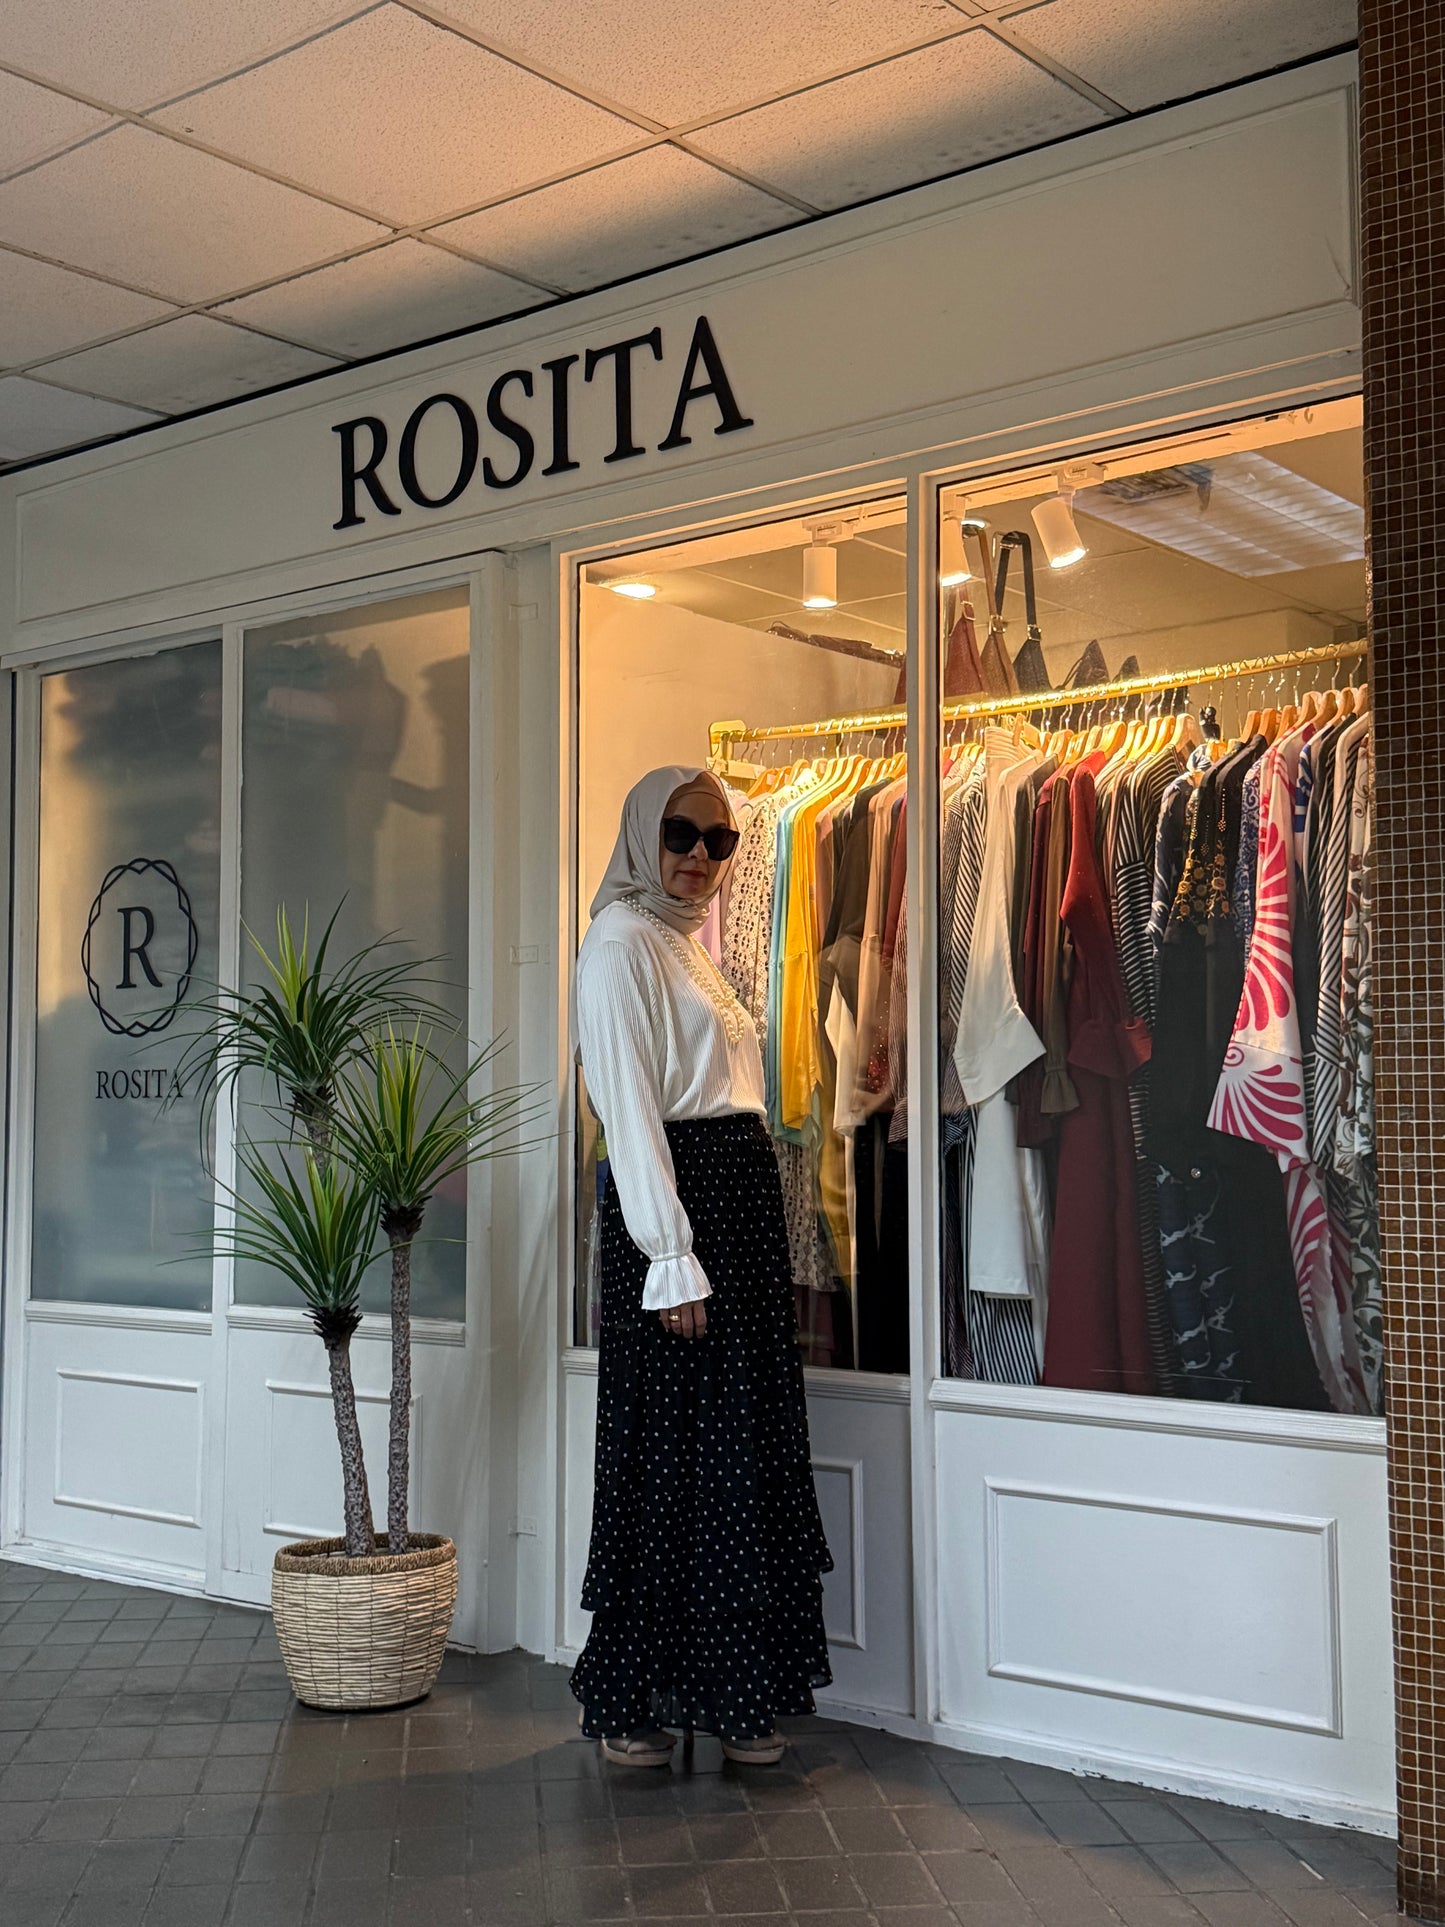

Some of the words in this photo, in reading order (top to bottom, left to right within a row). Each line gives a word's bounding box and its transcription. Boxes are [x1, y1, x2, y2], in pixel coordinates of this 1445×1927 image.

[331, 315, 754, 530] ROSITA
[115, 906, 163, 989] R
[95, 1069, 184, 1099] ROSITA
